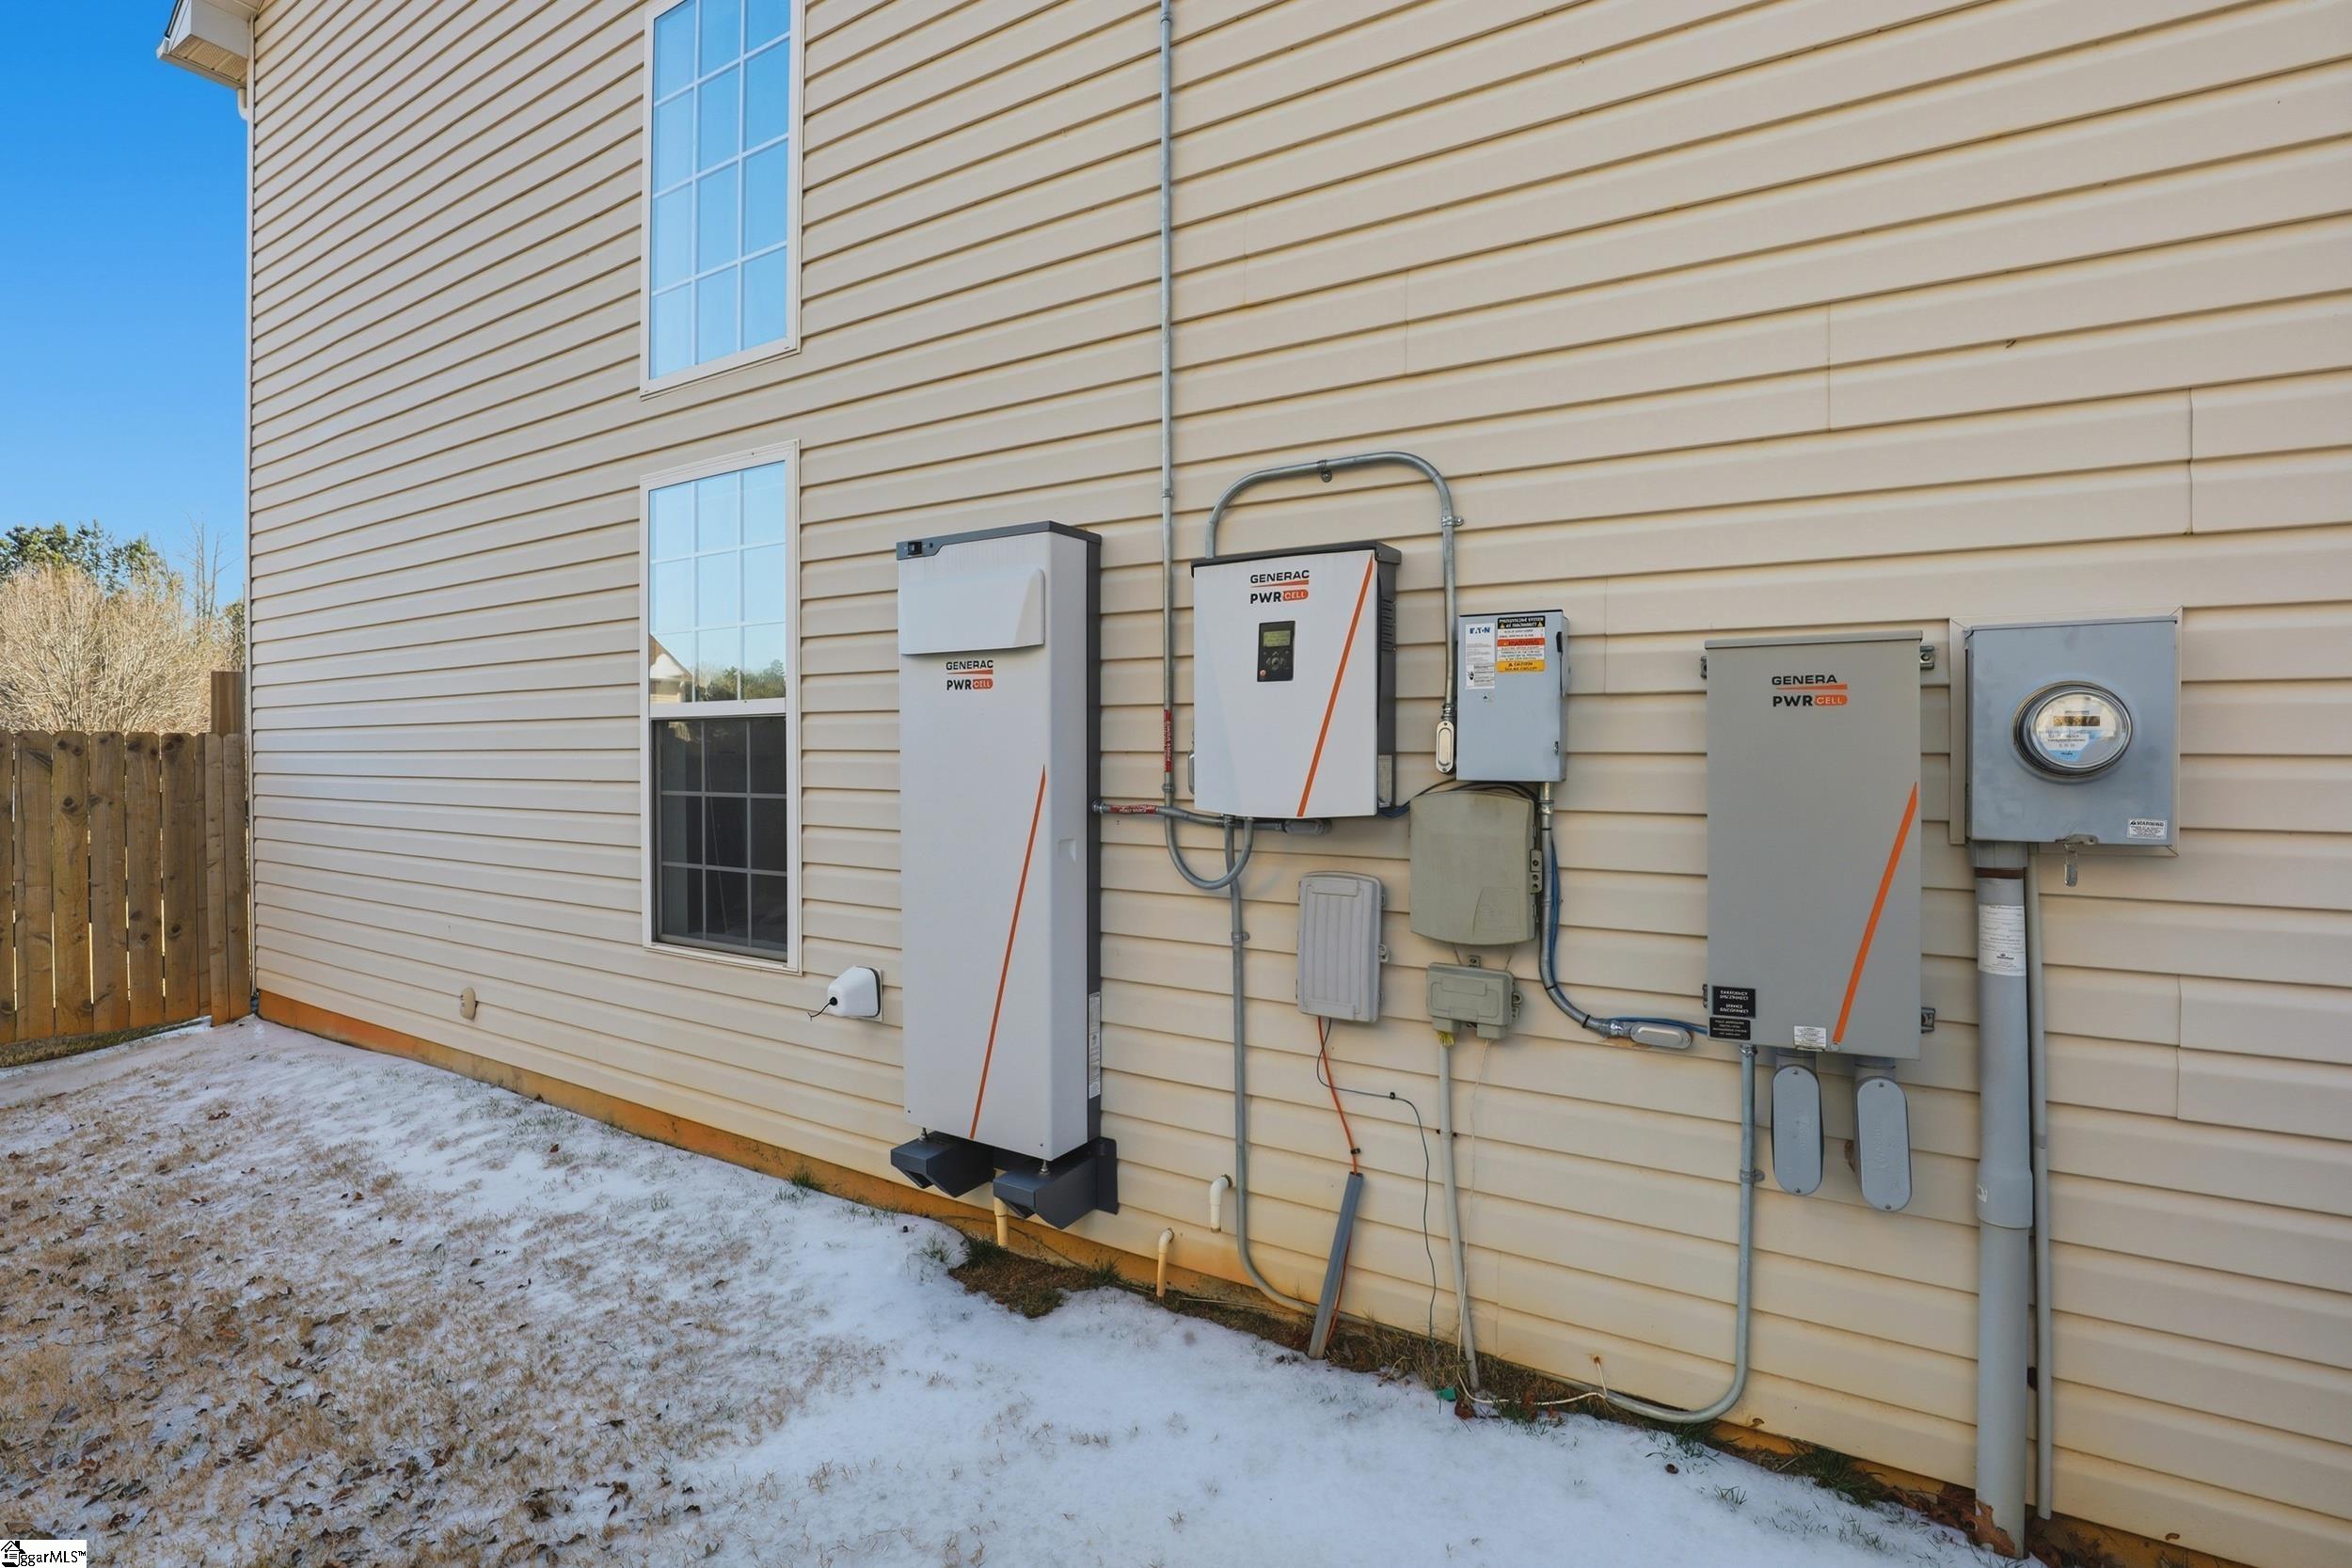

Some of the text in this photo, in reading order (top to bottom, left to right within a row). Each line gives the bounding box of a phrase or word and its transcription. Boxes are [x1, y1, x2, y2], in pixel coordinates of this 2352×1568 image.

[1249, 570, 1310, 583] GENERAC
[946, 659, 993, 671] GENERAC
[1772, 674, 1837, 685] GENERA
